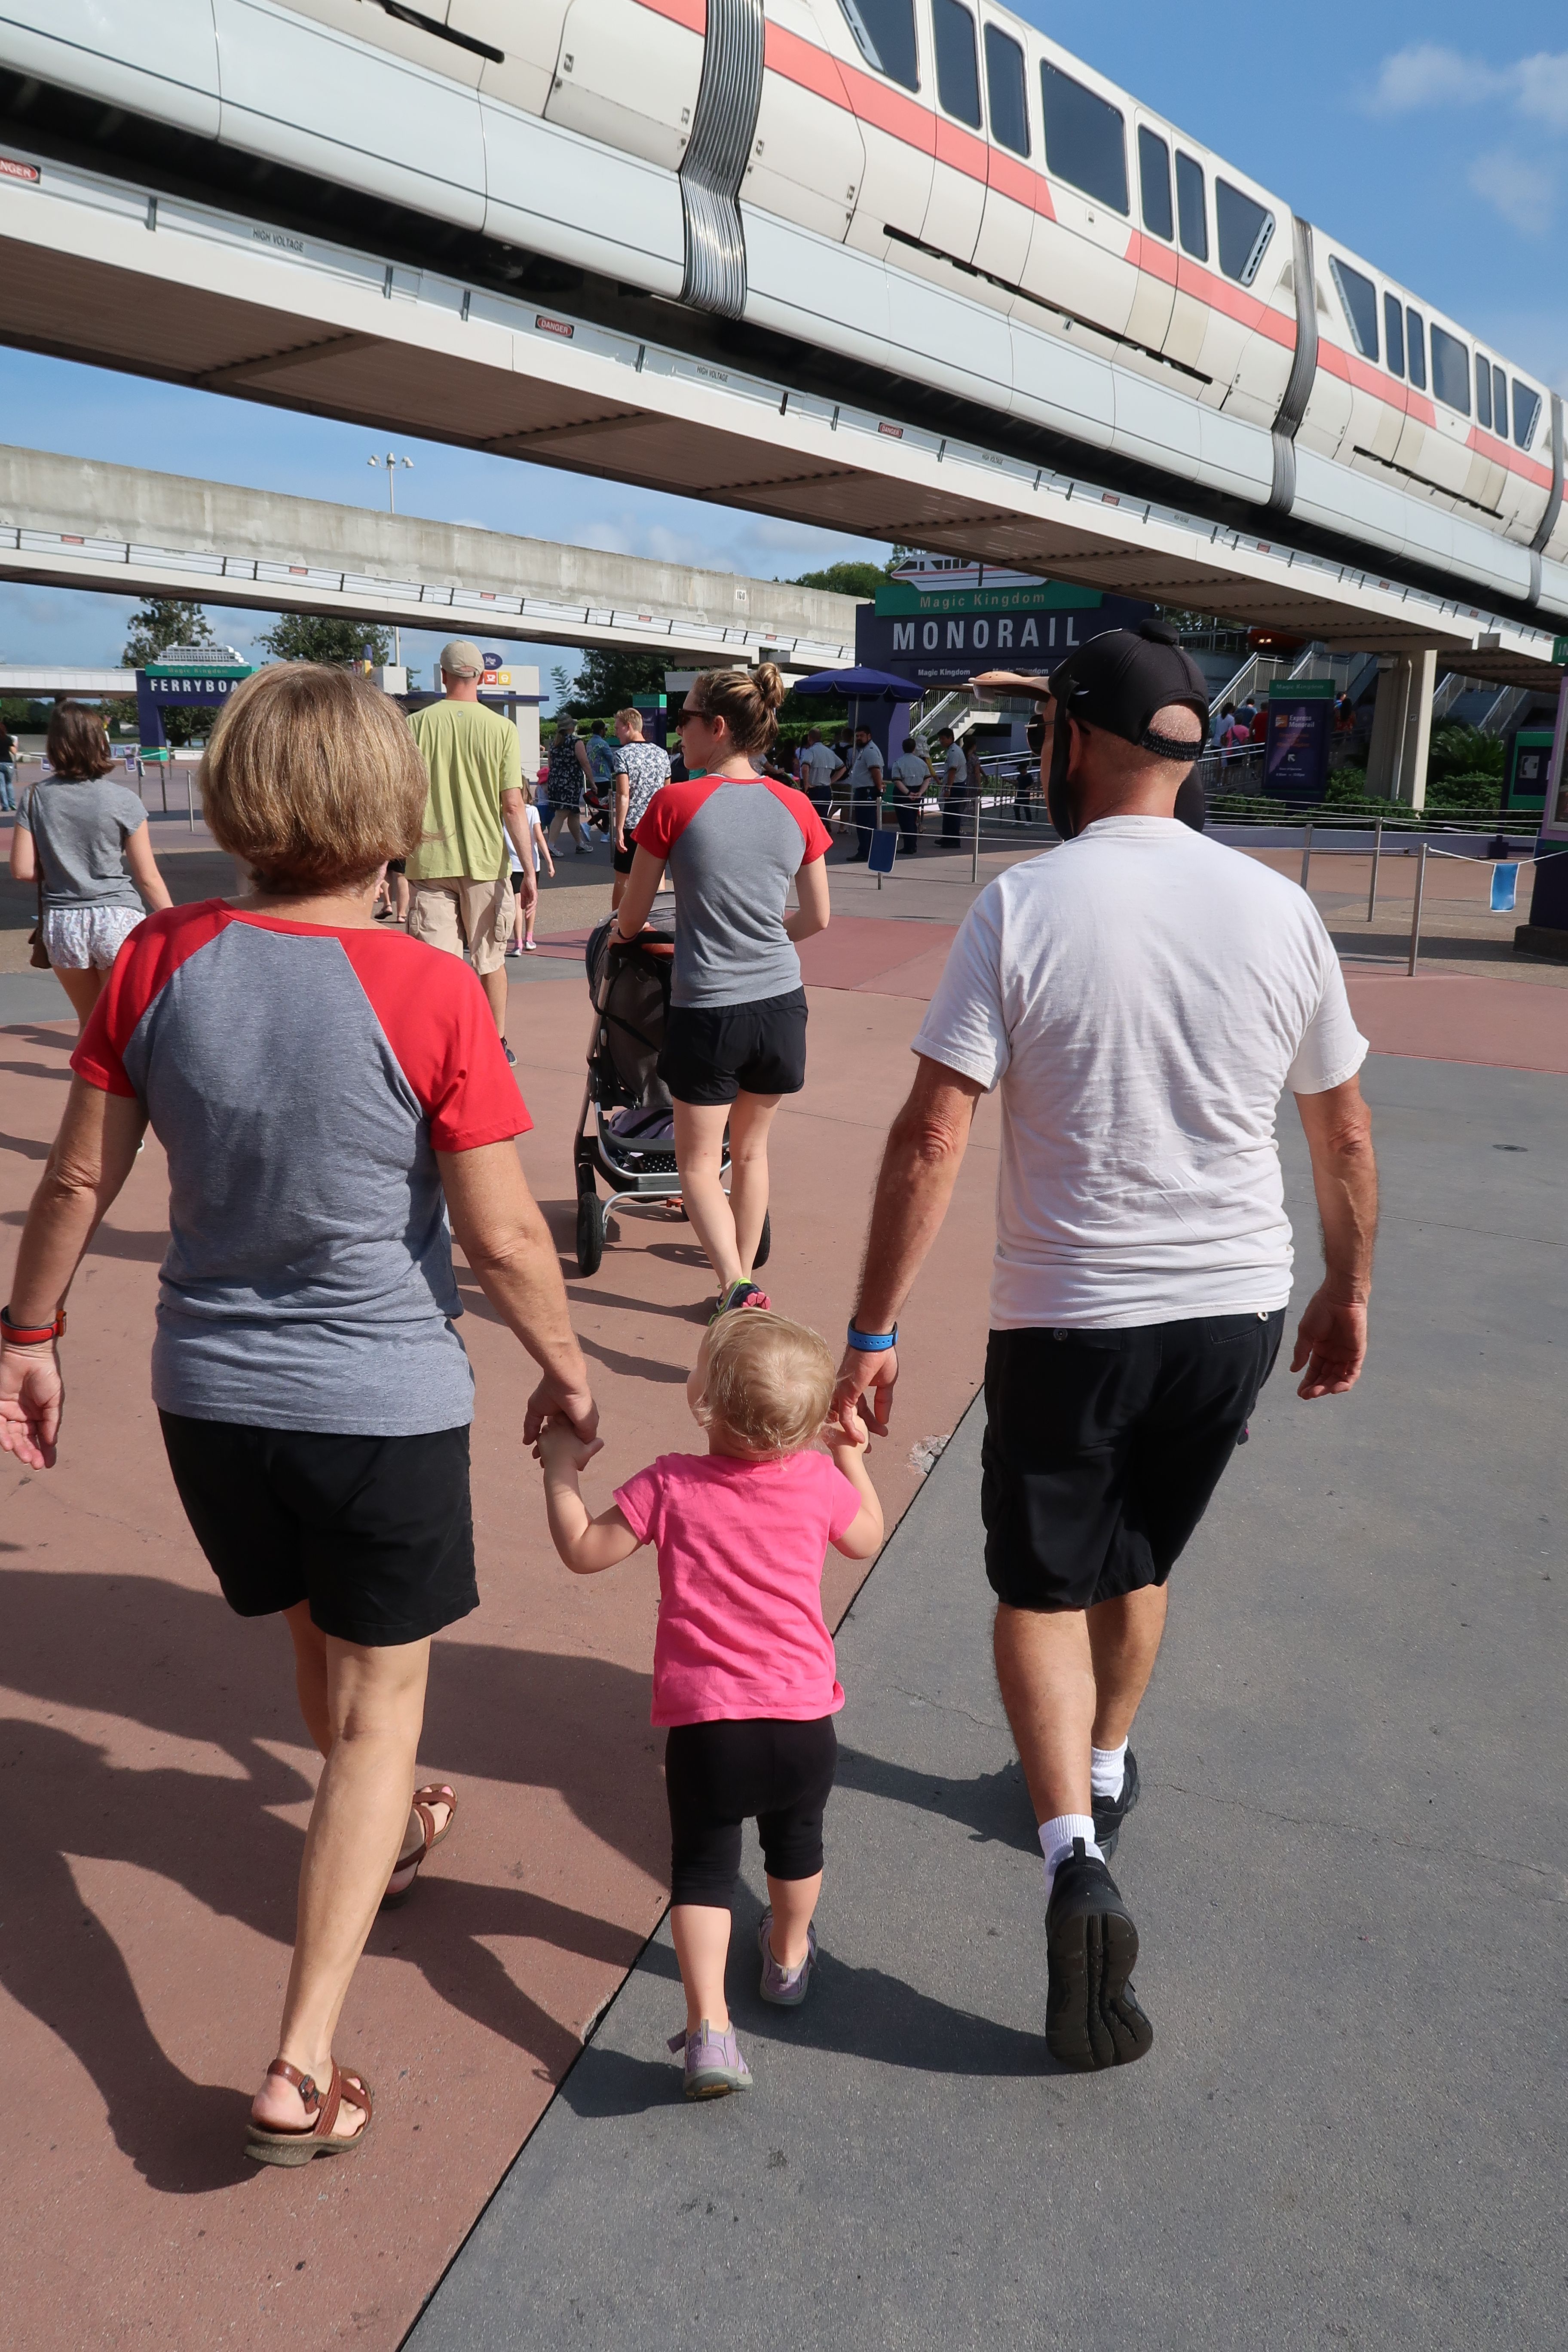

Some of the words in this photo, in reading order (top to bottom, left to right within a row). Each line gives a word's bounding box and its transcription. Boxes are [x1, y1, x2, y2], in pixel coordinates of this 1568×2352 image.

[252, 228, 270, 242] HIGH
[273, 233, 304, 252] VOLTAGE
[542, 318, 568, 334] DANGER
[697, 365, 708, 376] HIGH
[709, 369, 729, 383] VOLTAGE
[882, 426, 900, 436] DANGER
[920, 595, 965, 609] Magic
[974, 593, 1045, 607] Kingdom
[893, 617, 1079, 650] MONORAIL
[918, 668, 938, 677] Magic
[940, 668, 971, 677] Kingdom
